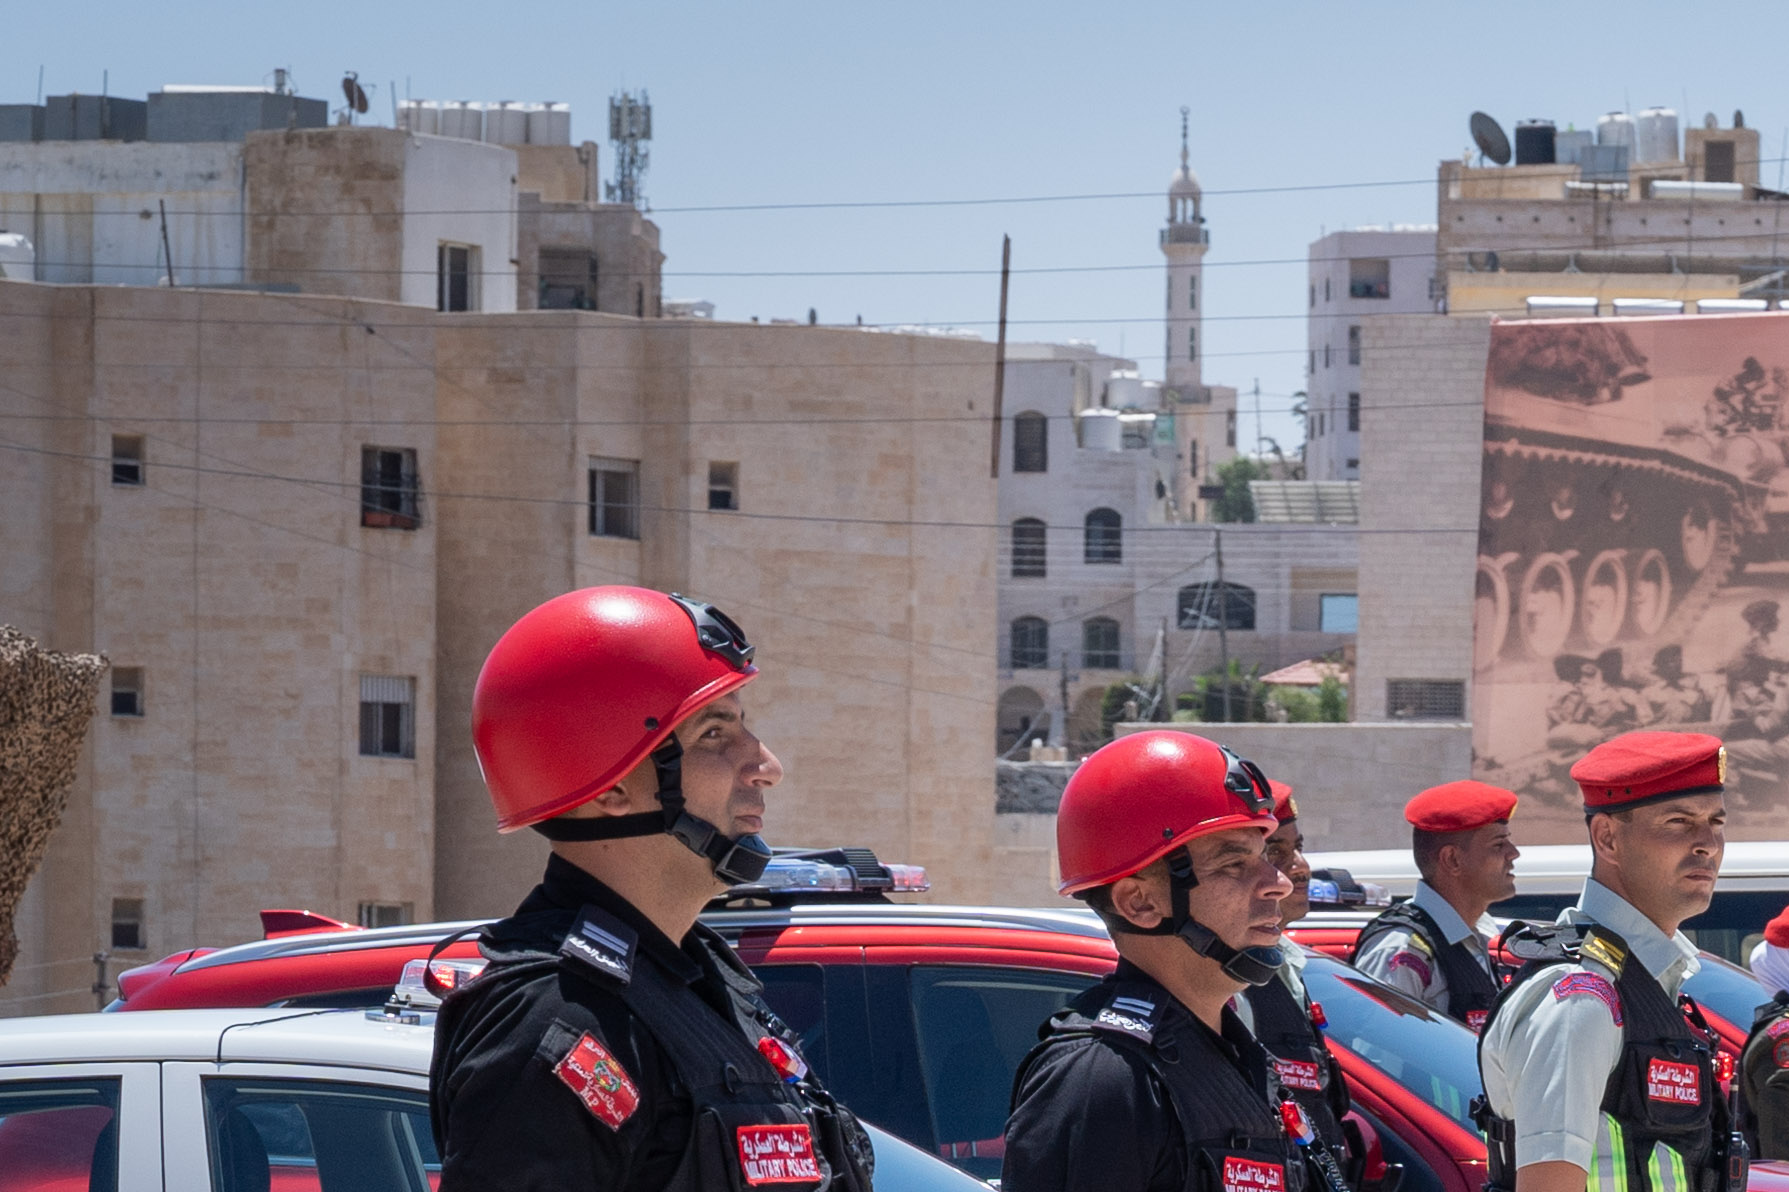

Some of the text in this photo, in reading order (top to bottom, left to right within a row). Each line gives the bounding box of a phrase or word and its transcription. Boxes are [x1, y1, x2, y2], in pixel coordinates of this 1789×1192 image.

[1670, 1067, 1694, 1086] الشرطة
[1648, 1083, 1698, 1101] MILITARY POLICE
[741, 1131, 806, 1159] الشرطة العسكرية
[744, 1158, 817, 1179] MILITARY POLICE
[1227, 1163, 1280, 1188] الشرطة العسكرية
